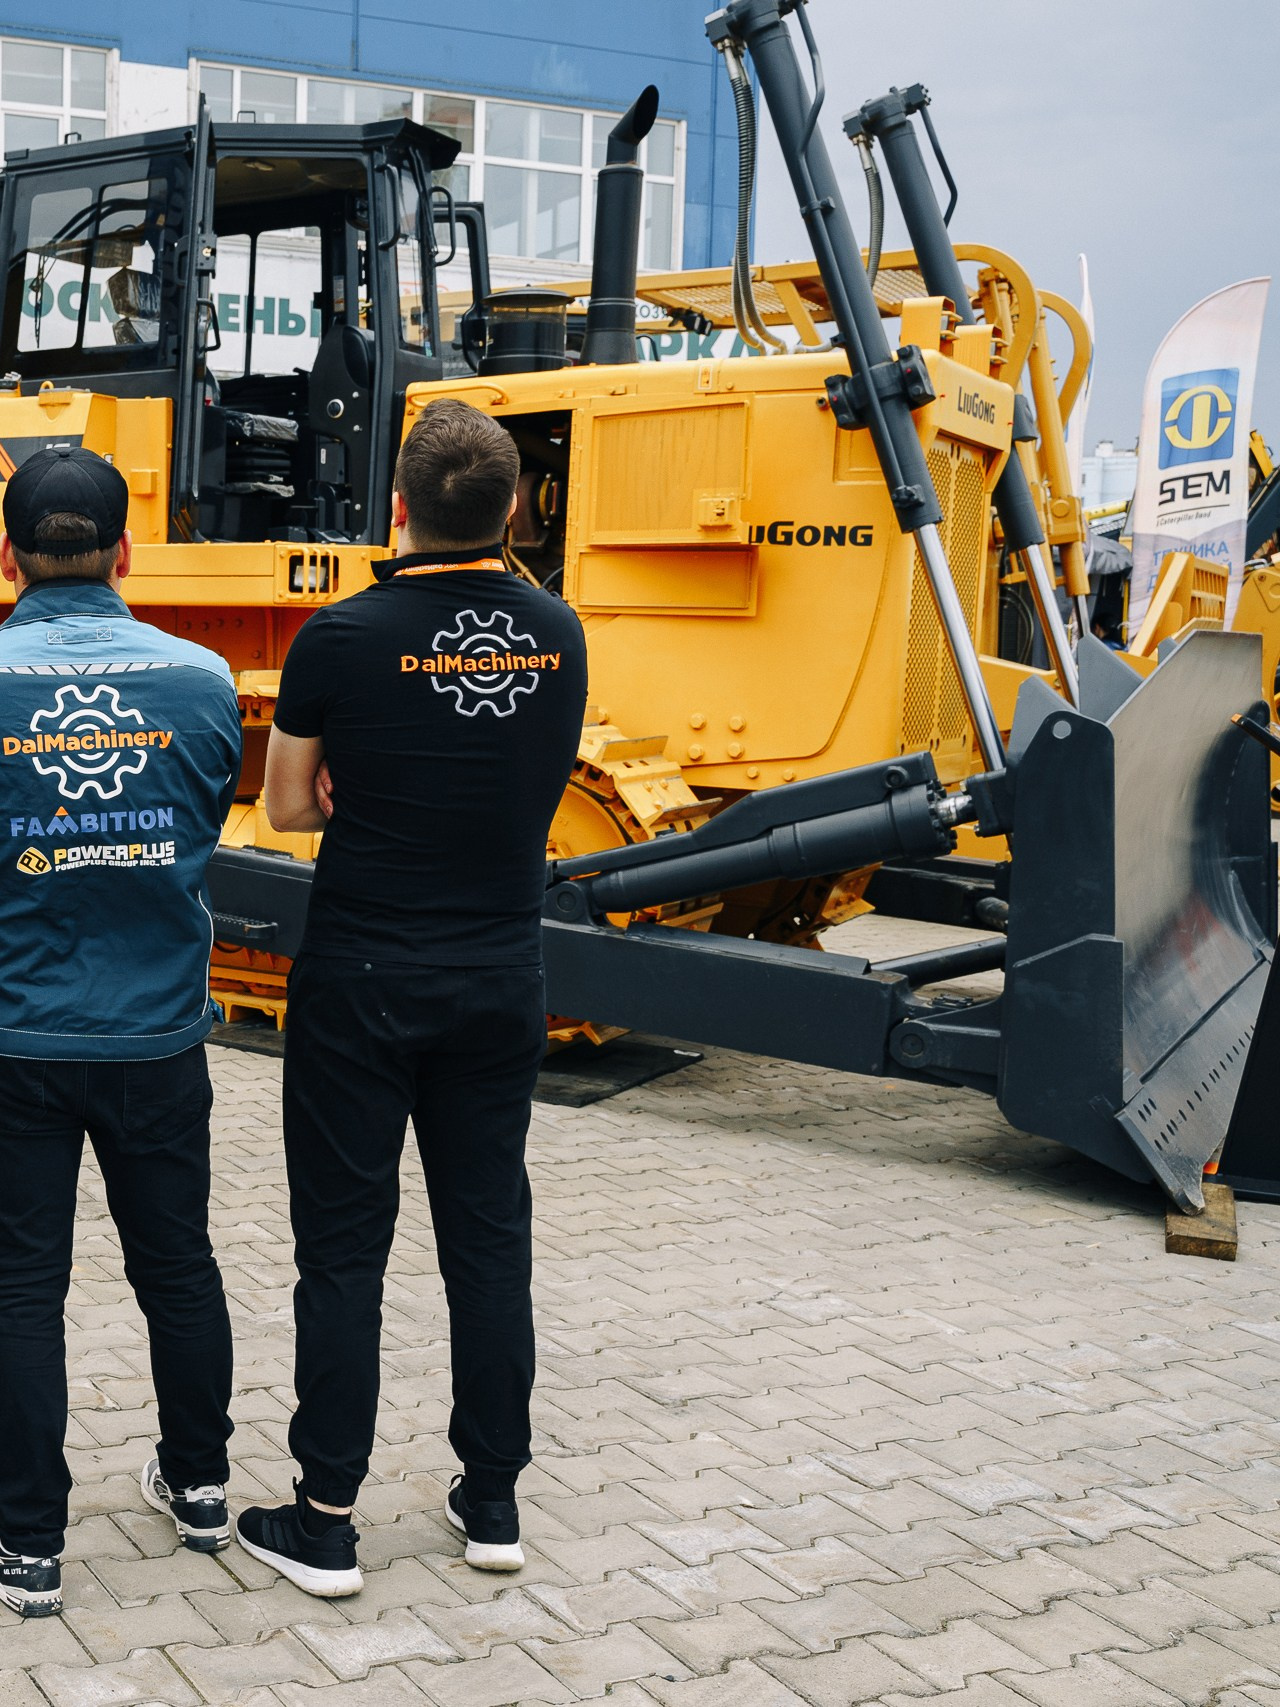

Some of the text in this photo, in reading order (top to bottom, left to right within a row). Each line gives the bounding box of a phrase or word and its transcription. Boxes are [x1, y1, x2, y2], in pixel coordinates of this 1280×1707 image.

[1158, 469, 1231, 507] SEM
[400, 651, 561, 674] DalMachinery
[2, 729, 173, 756] DalMachinery
[9, 806, 175, 837] FAMBITION
[53, 840, 176, 865] POWERPLUS
[55, 858, 107, 873] POWERPLUS
[108, 859, 139, 868] GROUP
[160, 856, 176, 866] USA
